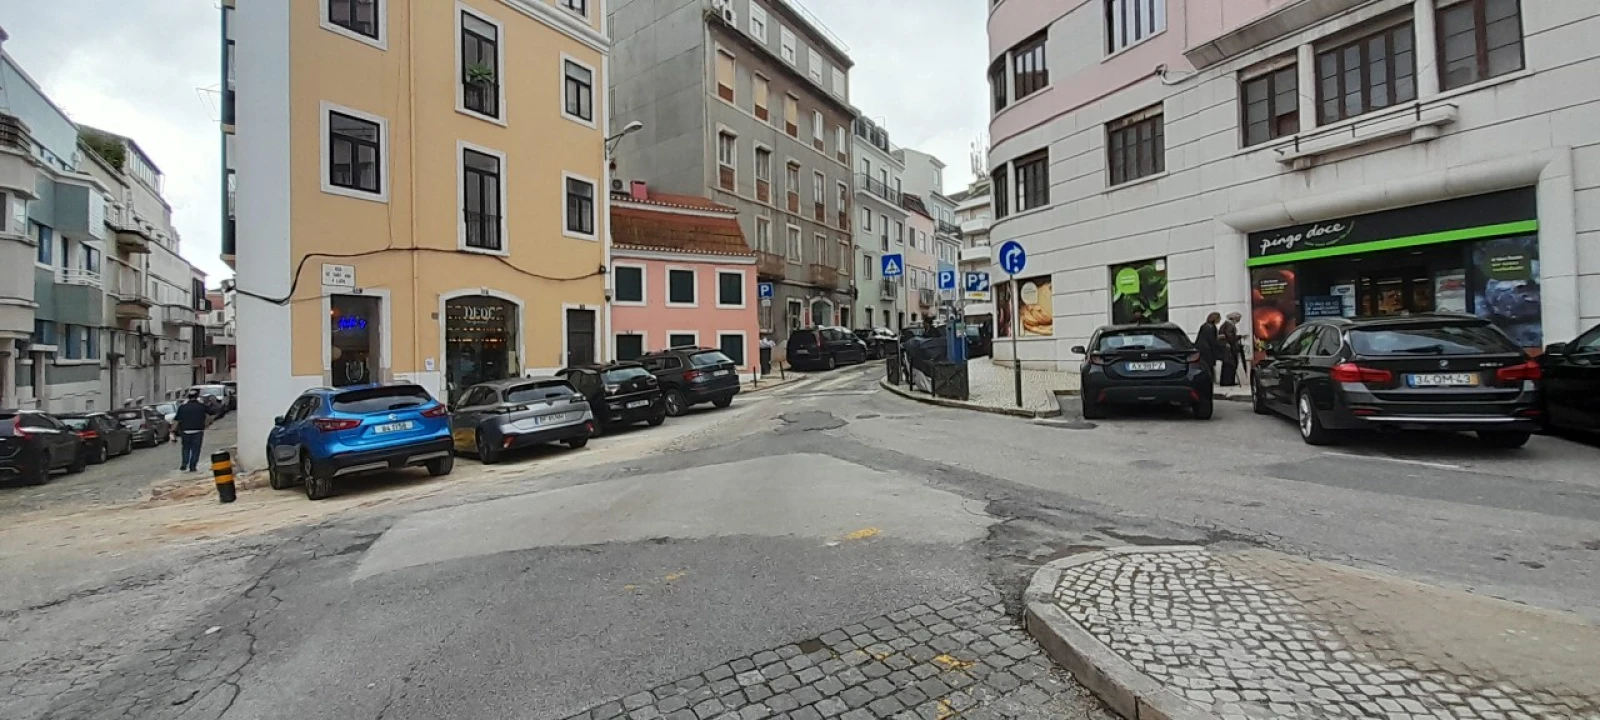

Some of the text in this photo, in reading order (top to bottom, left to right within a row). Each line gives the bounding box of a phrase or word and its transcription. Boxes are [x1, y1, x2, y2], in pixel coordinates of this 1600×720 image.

[1260, 234, 1302, 255] pingo
[1306, 223, 1345, 238] doce
[940, 272, 951, 288] P
[968, 274, 978, 287] P
[760, 285, 770, 296] P
